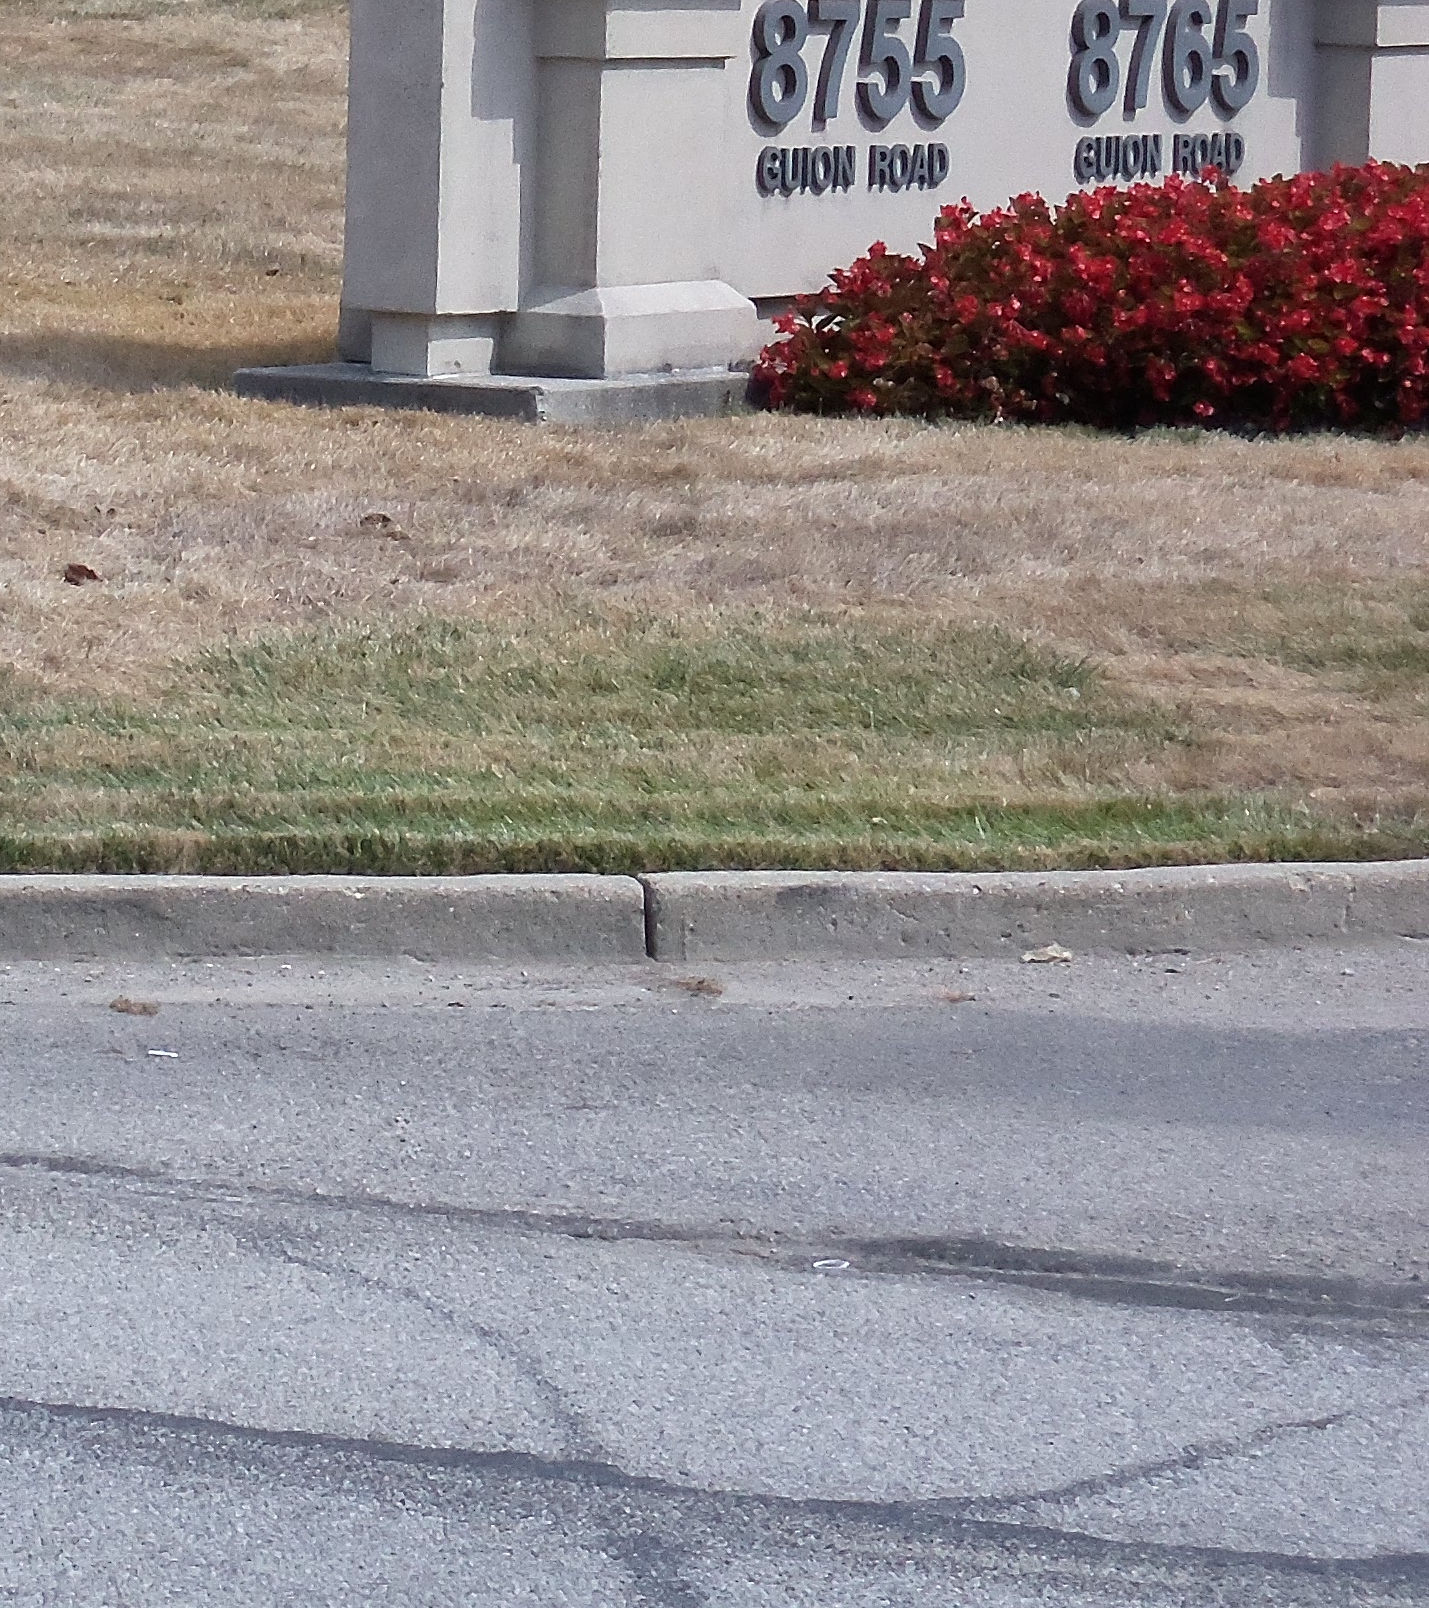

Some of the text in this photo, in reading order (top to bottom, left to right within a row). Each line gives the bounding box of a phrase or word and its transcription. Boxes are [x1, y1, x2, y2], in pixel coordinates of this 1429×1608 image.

[756, 143, 950, 196] GUION ROAD
[1073, 133, 1244, 184] GUION ROAD
